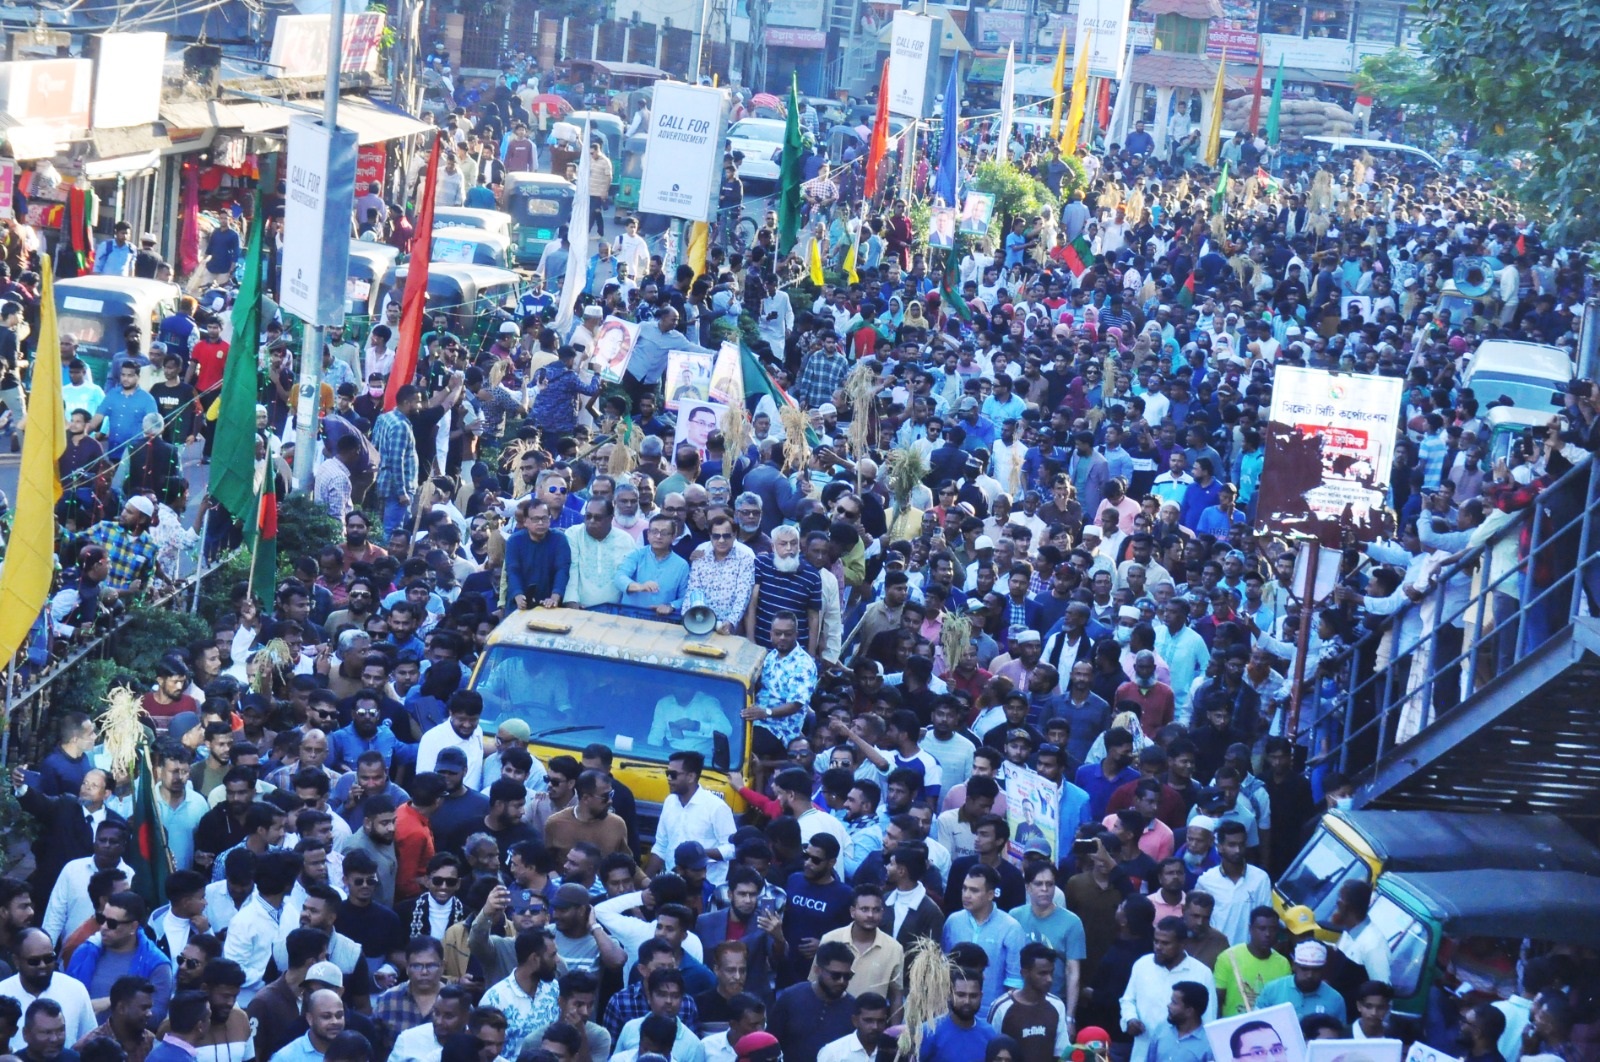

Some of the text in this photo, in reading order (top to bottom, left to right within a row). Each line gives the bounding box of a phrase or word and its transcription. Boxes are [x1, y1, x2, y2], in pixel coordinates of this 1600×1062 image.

[1102, 20, 1117, 29] FOR
[896, 36, 924, 51] CALL FOR
[659, 114, 710, 134] CALL FOR
[658, 130, 708, 145] ADVERTISEMENT
[291, 165, 321, 194] CALL FOR
[159, 396, 179, 405] value
[1282, 400, 1311, 415] সিলেট
[1315, 404, 1335, 417] সিটি
[792, 894, 827, 912] GUCCI
